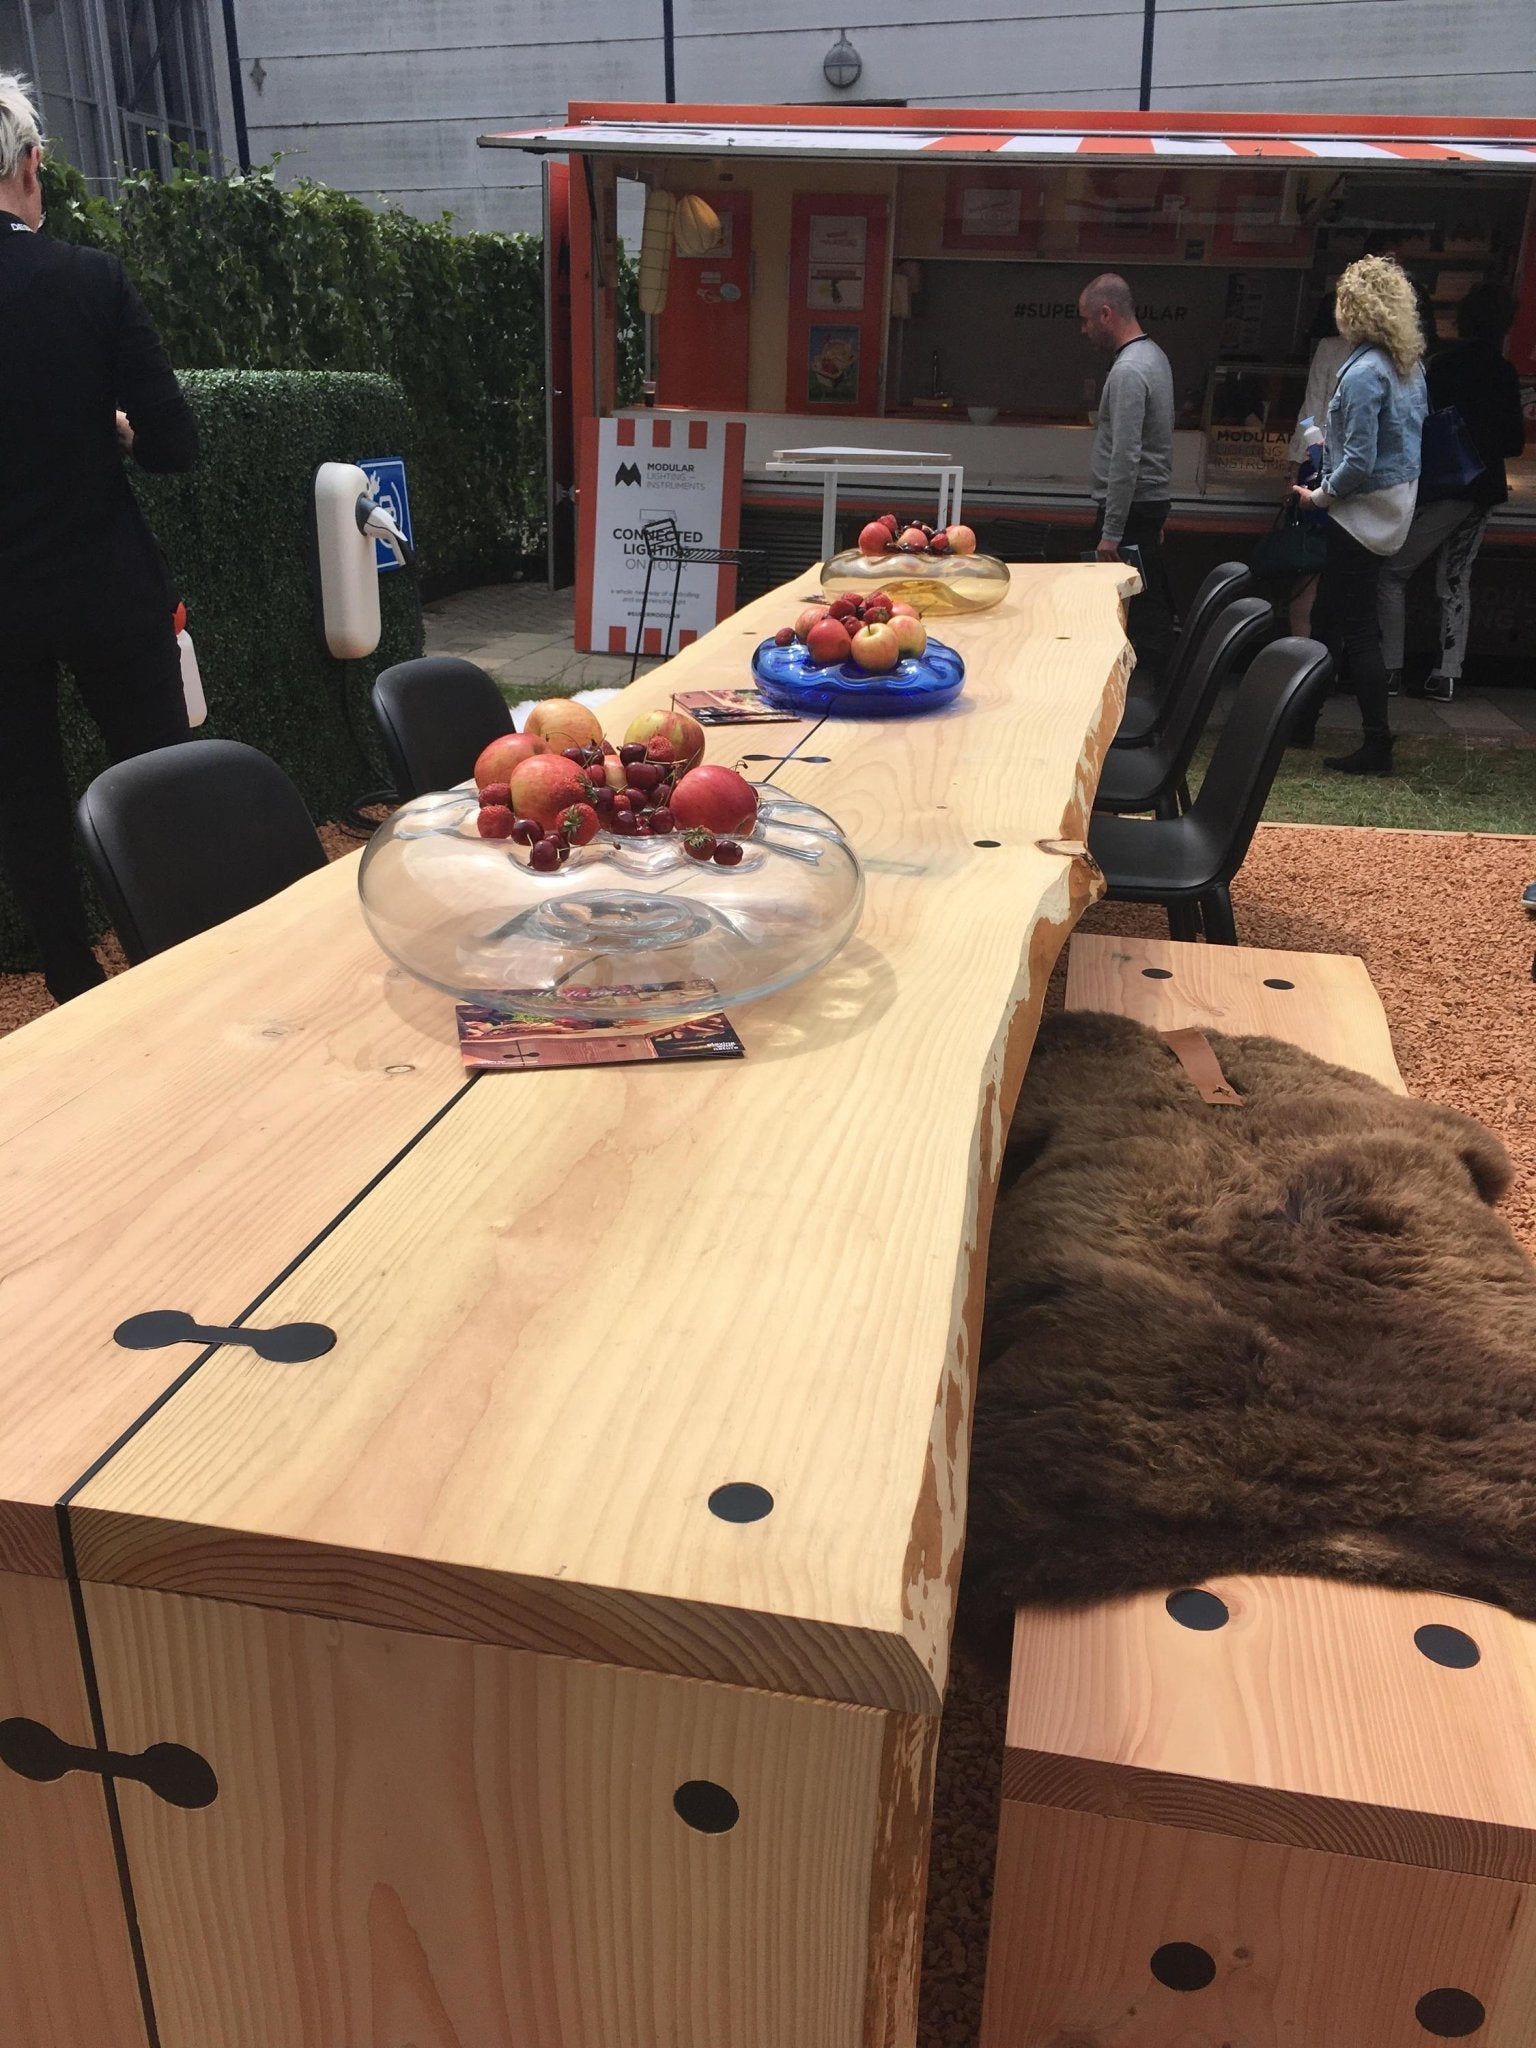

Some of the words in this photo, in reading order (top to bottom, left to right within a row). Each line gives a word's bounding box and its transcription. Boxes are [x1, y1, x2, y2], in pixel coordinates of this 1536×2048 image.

[647, 462, 695, 473] MODULAR
[646, 472, 686, 482] LIGHTING
[646, 481, 706, 491] INSTRUMENTS
[625, 558, 647, 570] ON
